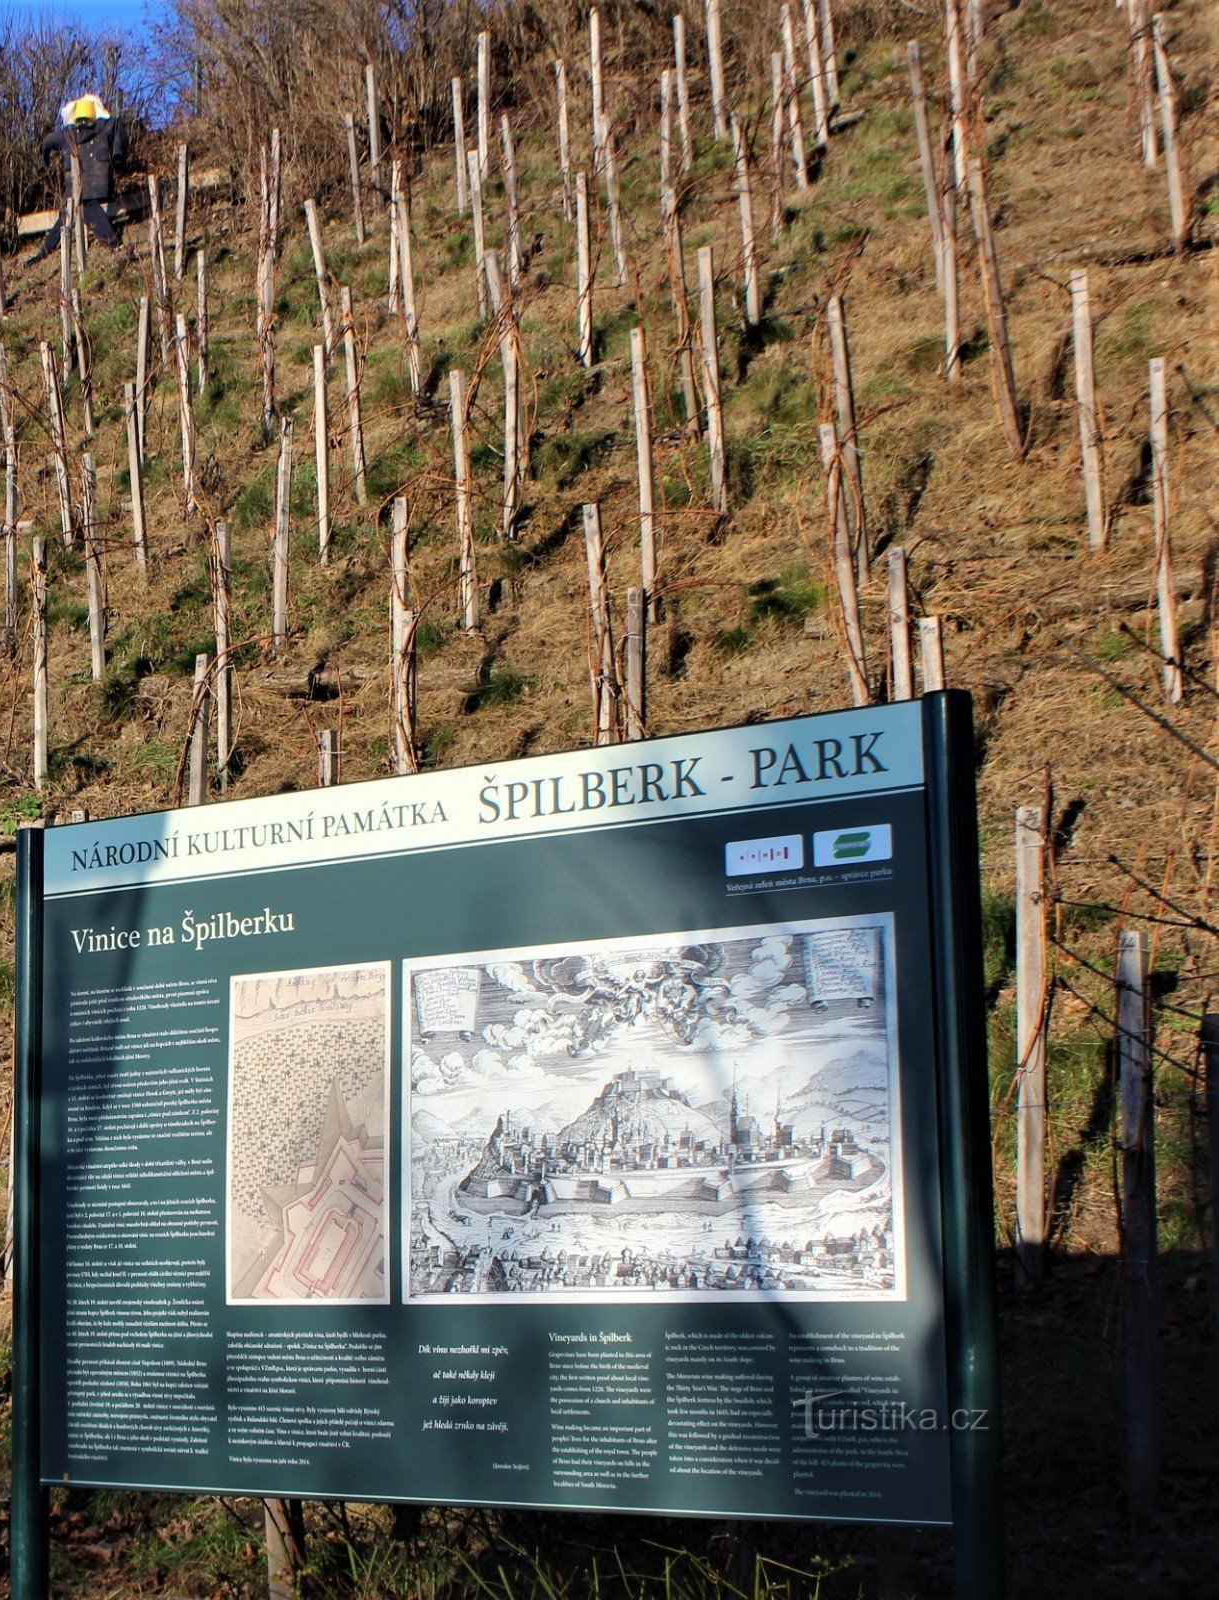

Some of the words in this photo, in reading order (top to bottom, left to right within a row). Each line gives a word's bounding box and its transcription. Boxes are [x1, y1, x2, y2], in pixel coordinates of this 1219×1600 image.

[71, 831, 181, 872] NÁRODNÍ
[187, 813, 315, 856] KULTURNÍ
[321, 800, 449, 838] PAMÁTKA
[478, 757, 706, 825] ŠPILBERK
[720, 774, 735, 783] -
[749, 731, 889, 790] PARK
[71, 926, 141, 954] Vinice
[146, 927, 177, 946] na
[182, 907, 295, 949] Špilberku
[548, 1332, 587, 1344] Vineyards
[588, 1332, 597, 1342] in
[598, 1331, 632, 1344] Špilberk
[418, 1344, 431, 1354] Dík
[432, 1344, 448, 1354] vínu
[448, 1344, 479, 1354] nezhořkl
[480, 1345, 490, 1354] mi
[491, 1345, 509, 1356] zpěv,
[432, 1370, 441, 1379] ač
[442, 1370, 457, 1379] také
[458, 1370, 479, 1381] někdy
[479, 1370, 496, 1382] kleji
[438, 1395, 449, 1406] žiji
[450, 1395, 466, 1407] jako
[467, 1395, 498, 1407] koroptev
[422, 1420, 432, 1431] jež
[433, 1420, 453, 1430] hledá
[453, 1420, 474, 1430] zrnko
[486, 1421, 509, 1432] závěji.
